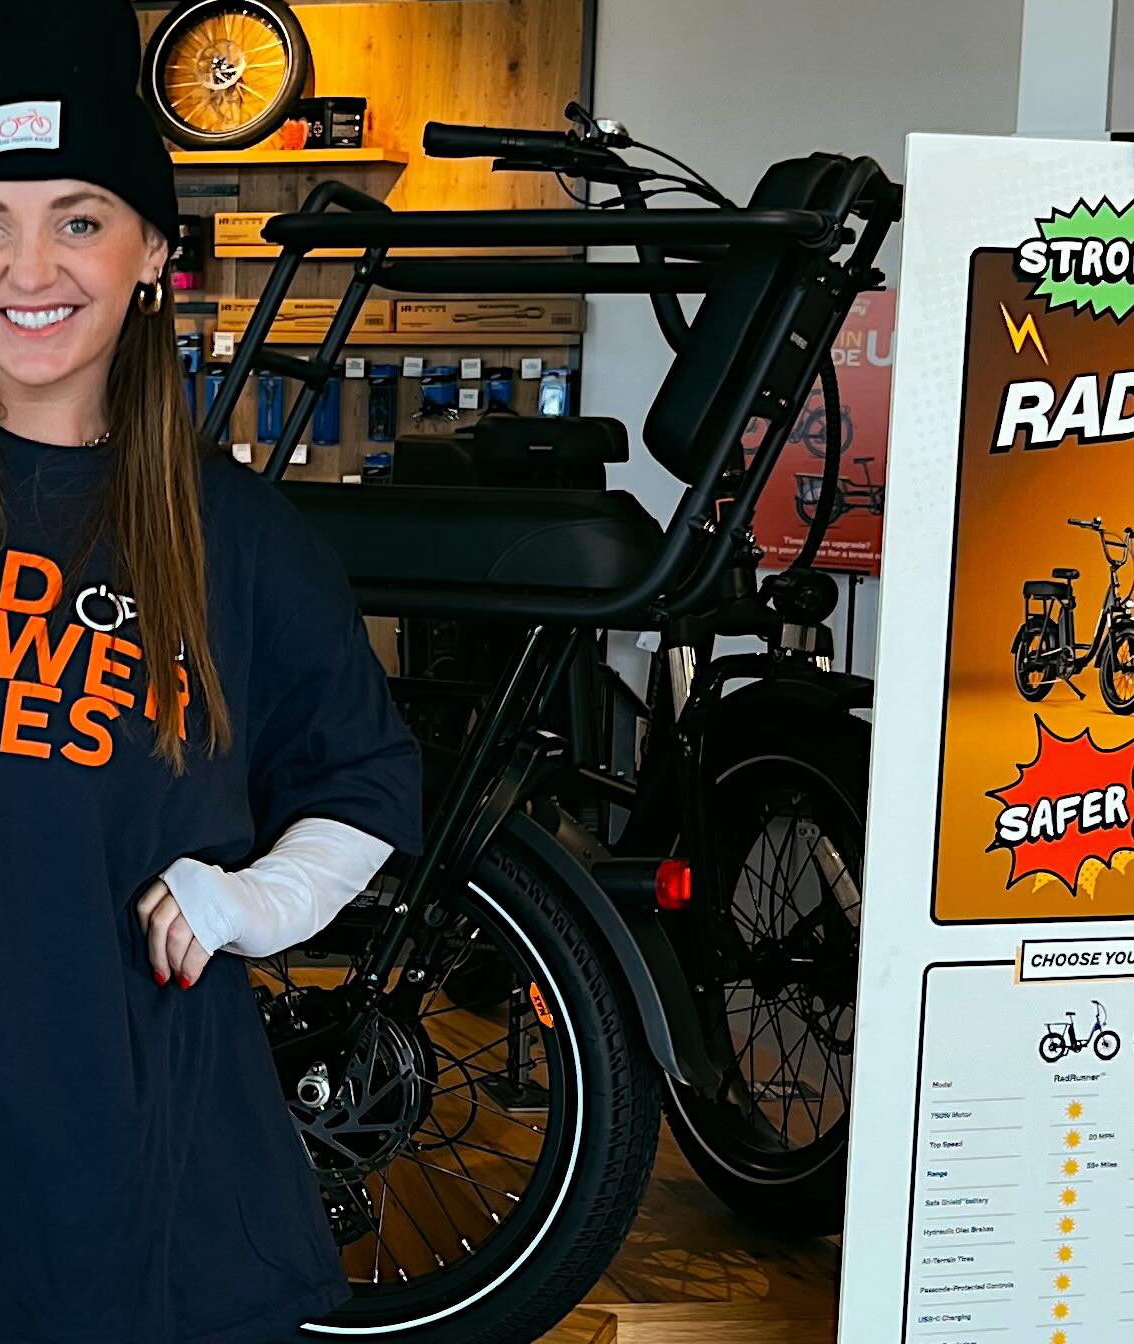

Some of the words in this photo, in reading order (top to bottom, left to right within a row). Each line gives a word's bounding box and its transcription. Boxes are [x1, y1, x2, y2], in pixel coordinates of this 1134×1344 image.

[1019, 239, 1134, 278] STRO
[999, 785, 1130, 842] SAFER
[1031, 952, 1102, 968] CHOOSE
[927, 1170, 948, 1178] Range
